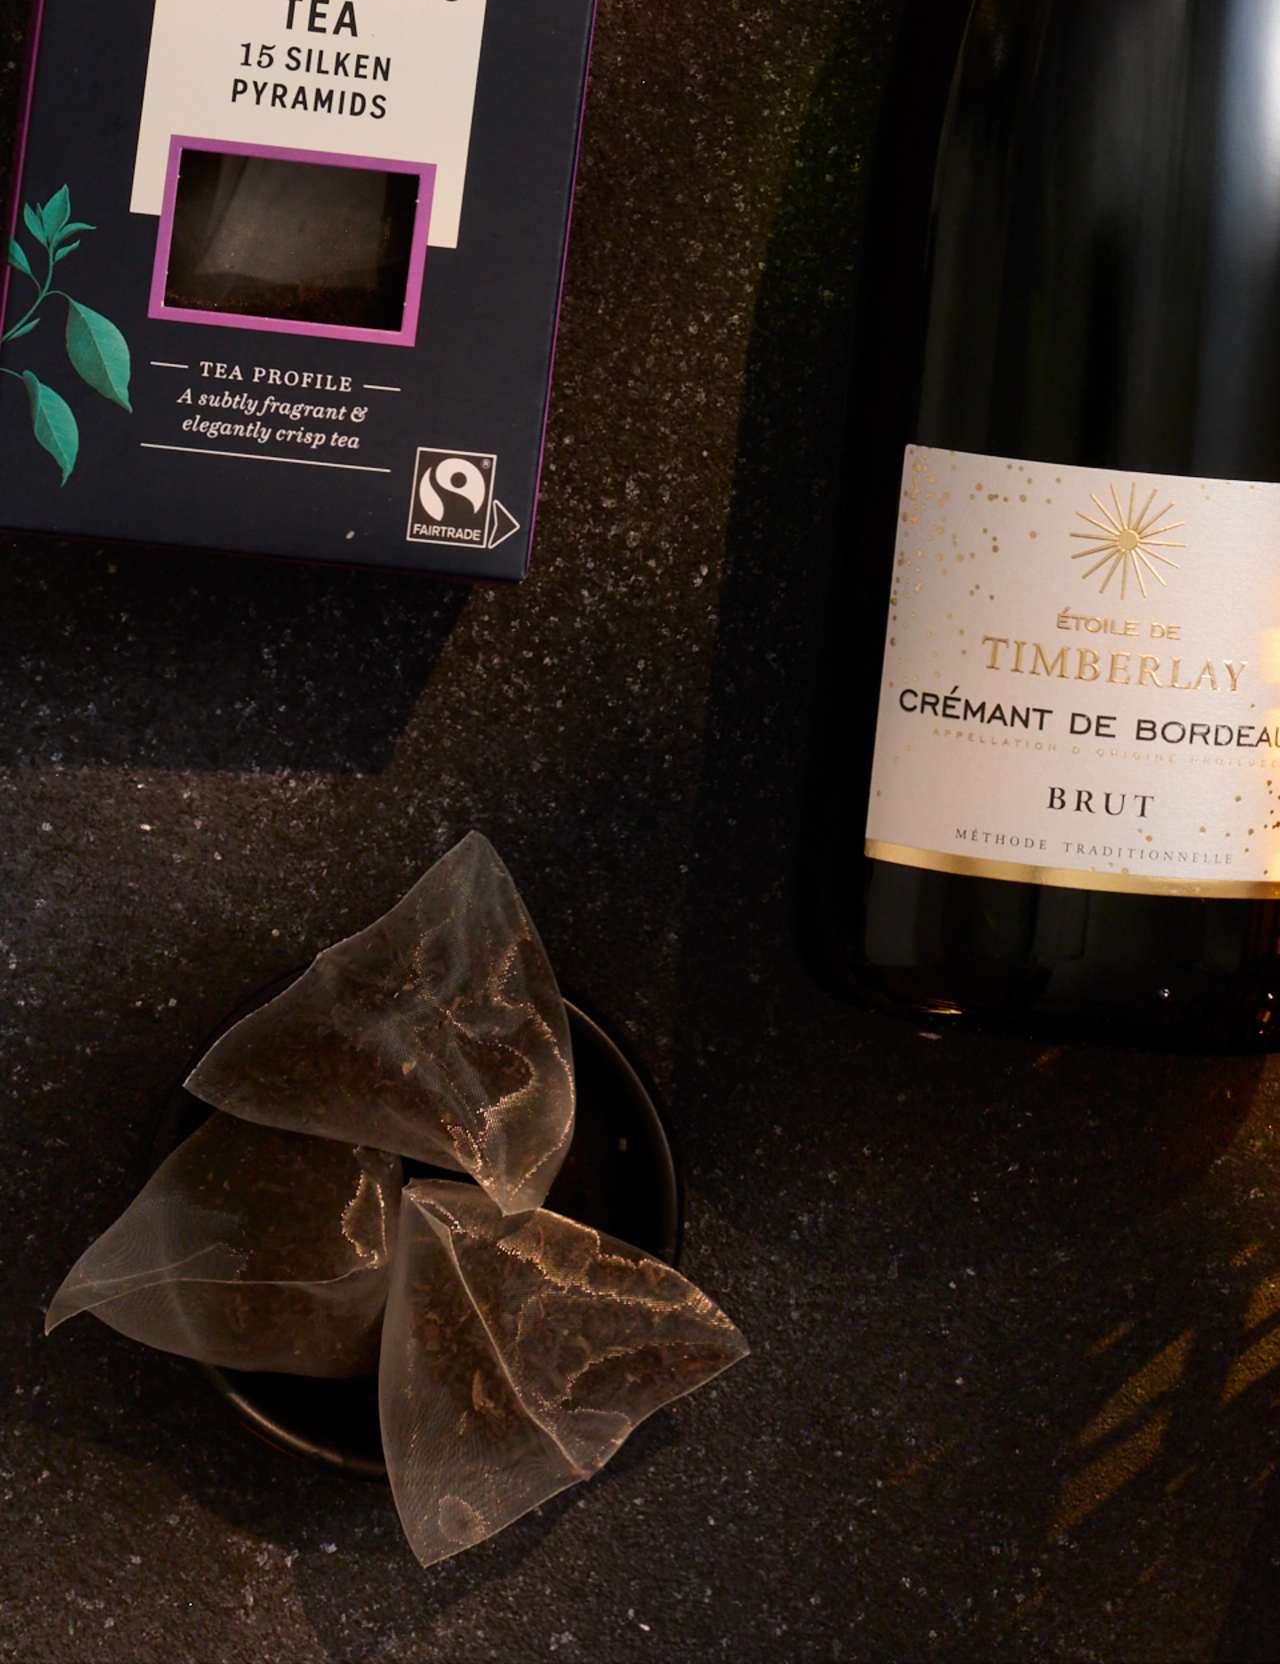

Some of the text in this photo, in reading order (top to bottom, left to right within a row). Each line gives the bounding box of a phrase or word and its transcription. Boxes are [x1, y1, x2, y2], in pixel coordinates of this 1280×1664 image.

[240, 42, 391, 82] 15 SILKEN
[231, 78, 387, 119] PYRAMIDS
[200, 361, 352, 392] TEA PROFILE
[177, 388, 369, 423] A subtly fragrant &
[182, 415, 361, 450] elegantly crisp tea
[412, 523, 482, 541] FAIRTRADE
[1056, 607, 1181, 641] ÉTOILE DE
[982, 634, 1249, 693] TIMBERLAY
[899, 686, 1054, 731] CRÉMANT
[1069, 712, 1117, 738] DE
[931, 727, 1056, 752] APPELLATION
[1047, 786, 1155, 818] BRUT
[955, 827, 1233, 865] MÉTHODE TRADITIONNELLE
